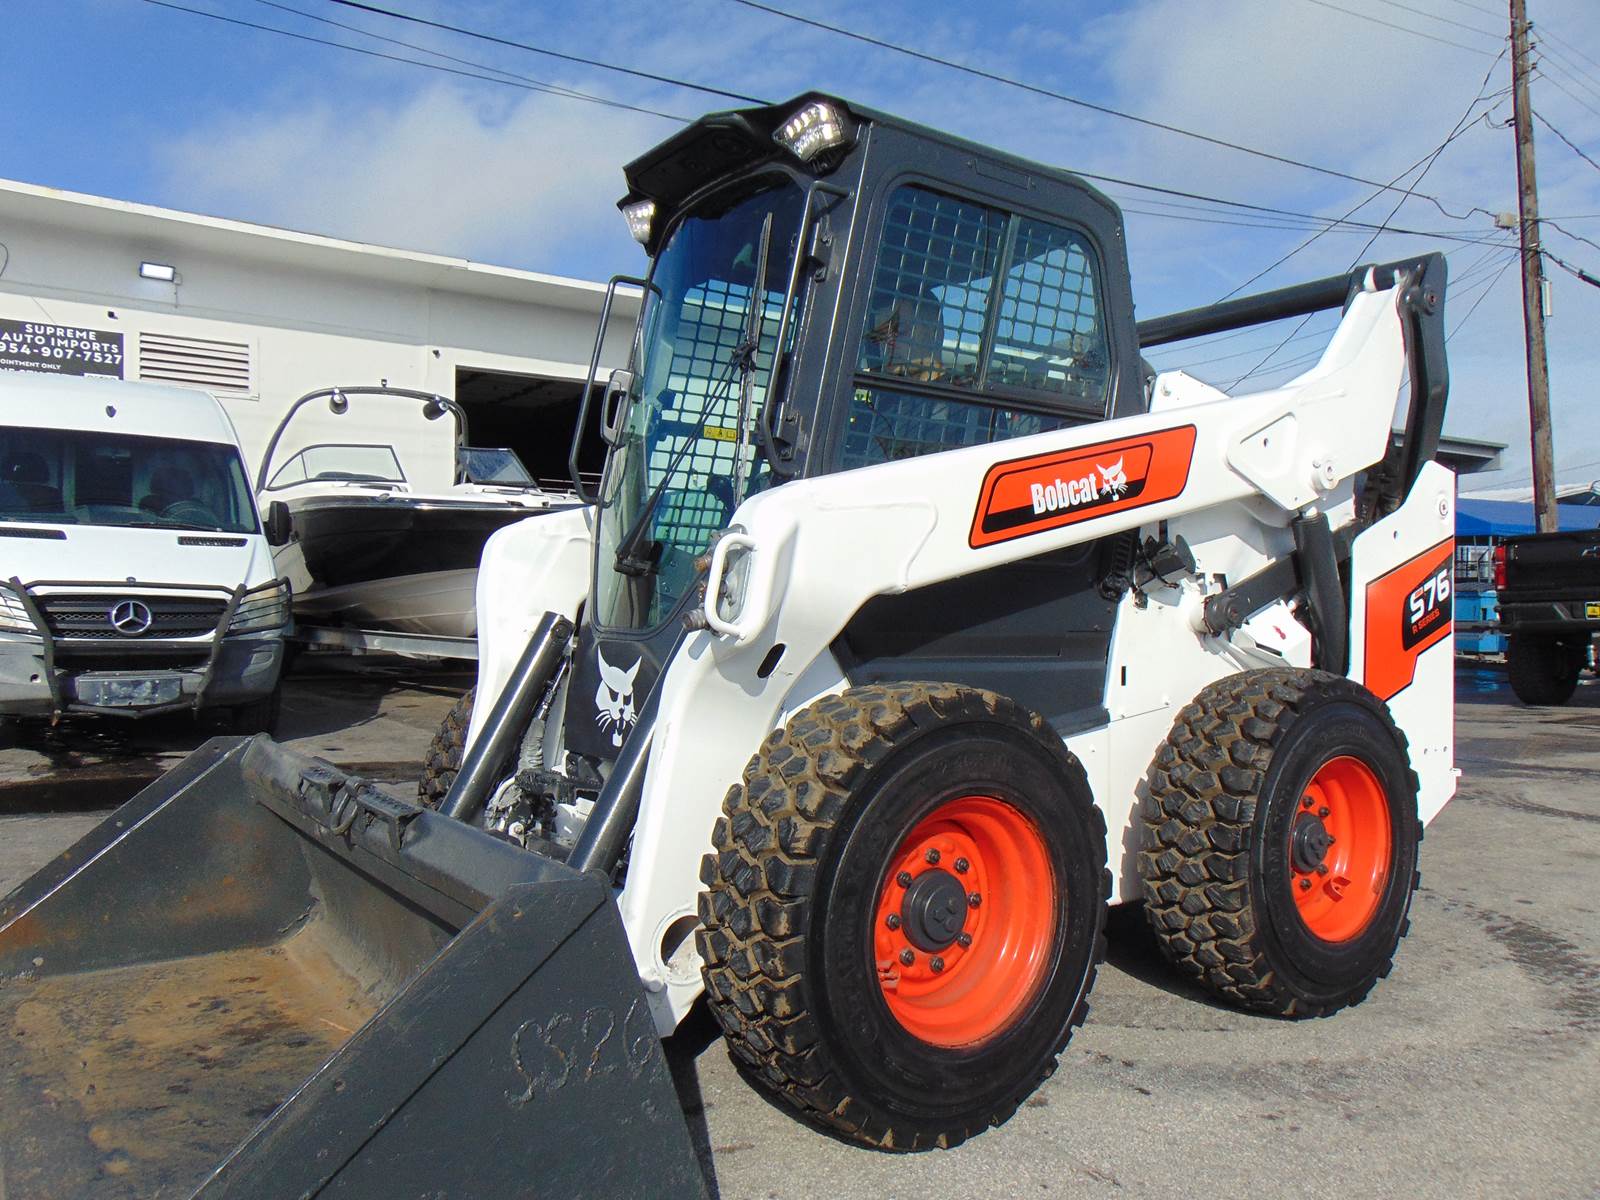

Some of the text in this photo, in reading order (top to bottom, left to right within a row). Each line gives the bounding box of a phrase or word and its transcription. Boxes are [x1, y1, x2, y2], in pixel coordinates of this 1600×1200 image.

[1, 332, 119, 353] AUTO IMPORTS
[25, 324, 97, 340] SUPREME
[0, 342, 122, 364] 954-907-7527
[41, 362, 61, 370] ONLY
[1030, 473, 1099, 514] Bobcat
[1410, 568, 1449, 624] S76
[1412, 608, 1440, 634] R SERIES
